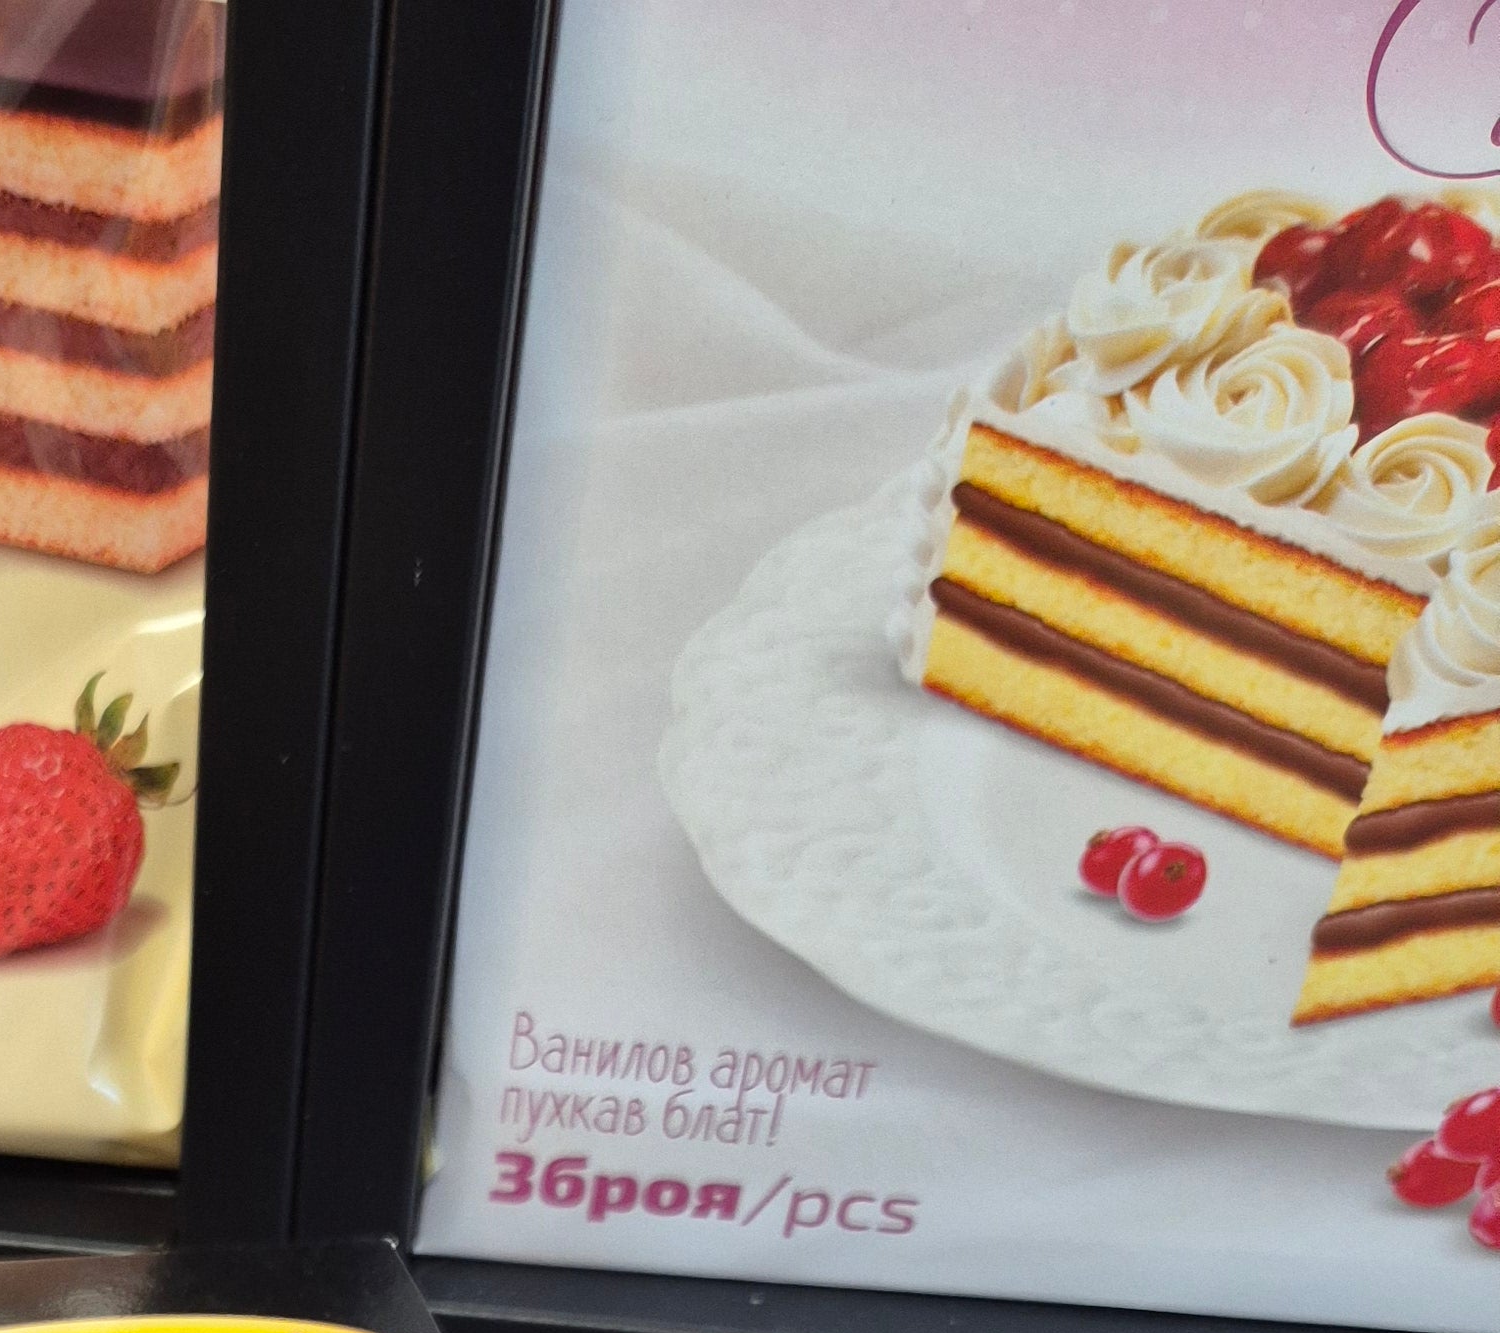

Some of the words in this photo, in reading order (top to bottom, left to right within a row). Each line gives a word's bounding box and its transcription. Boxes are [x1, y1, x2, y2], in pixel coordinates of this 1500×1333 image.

[508, 1011, 695, 1086] Ванилов
[709, 1047, 878, 1100] аромат
[500, 1085, 647, 1143] пухкав
[662, 1089, 784, 1147] блат!
